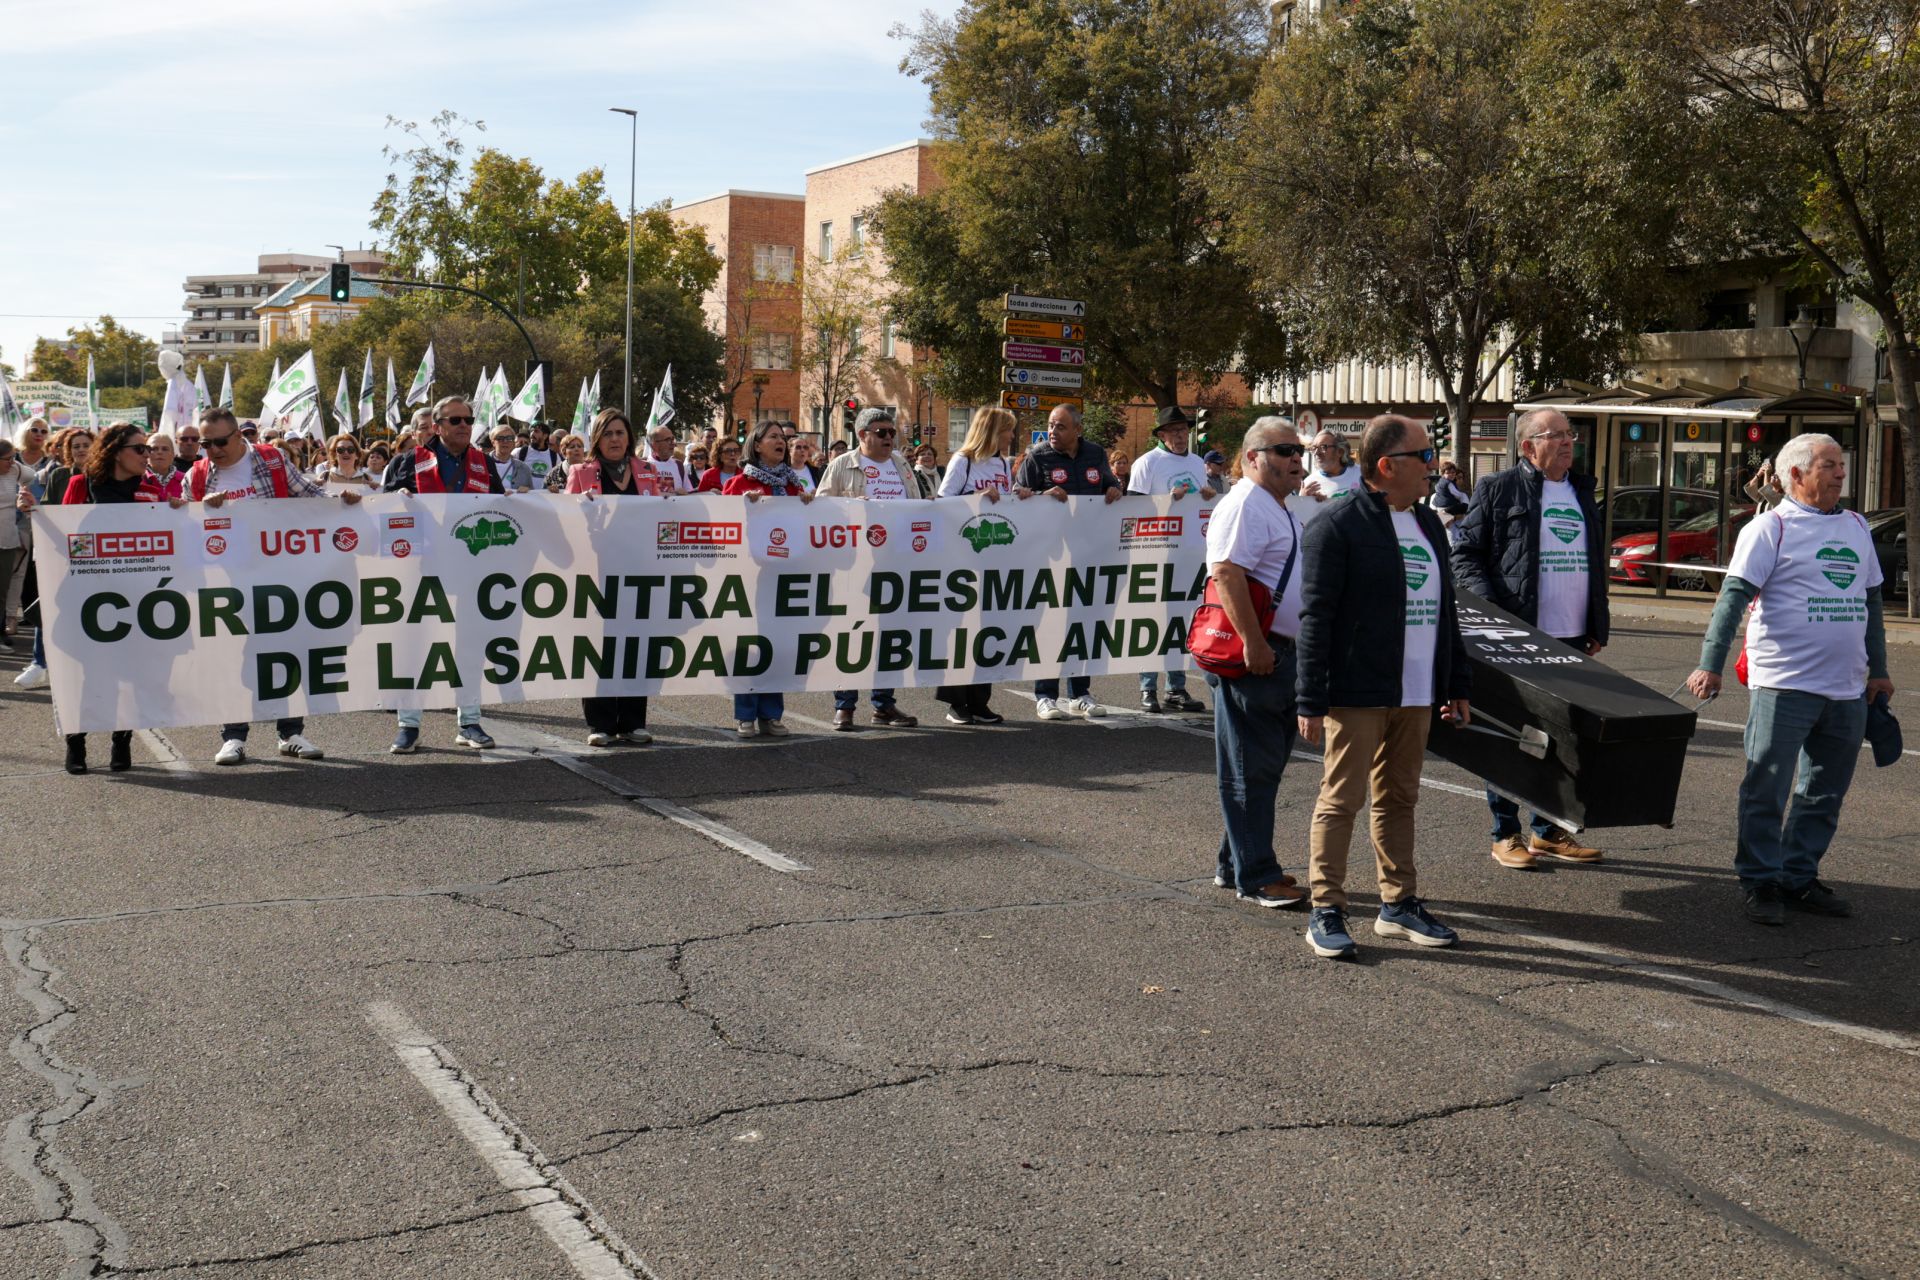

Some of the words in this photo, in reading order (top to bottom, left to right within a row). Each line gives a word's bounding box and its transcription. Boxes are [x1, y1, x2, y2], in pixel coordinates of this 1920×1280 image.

[1009, 299, 1028, 308] todas
[1030, 301, 1067, 311] direcciones
[1061, 376, 1081, 384] ciudad
[872, 487, 903, 496] Sanidad
[1138, 520, 1179, 533] CCOO
[683, 526, 738, 540] CCOO
[809, 525, 862, 549] UGT
[101, 535, 169, 553] CCOO
[260, 528, 326, 556] UGT
[70, 558, 111, 567] federación
[112, 557, 123, 565] de
[124, 556, 155, 565] sanidad
[77, 567, 110, 576] sectores
[112, 565, 171, 574] sociosanitarios
[1807, 596, 1844, 604] Plataforma
[80, 577, 456, 643] CÓRDOBA
[476, 573, 754, 621] CONTRA
[774, 572, 848, 618] EL
[1820, 606, 1847, 614] Hospital
[1205, 627, 1232, 641] SPORT
[1475, 643, 1550, 652] D.E.P.
[256, 645, 349, 702] DE
[376, 641, 464, 691] LA
[483, 632, 775, 686] SANIDAD
[794, 620, 1042, 676] PÚBLICA
[1056, 615, 1191, 664] ANDA
[1485, 655, 1583, 664] 2019-2026
